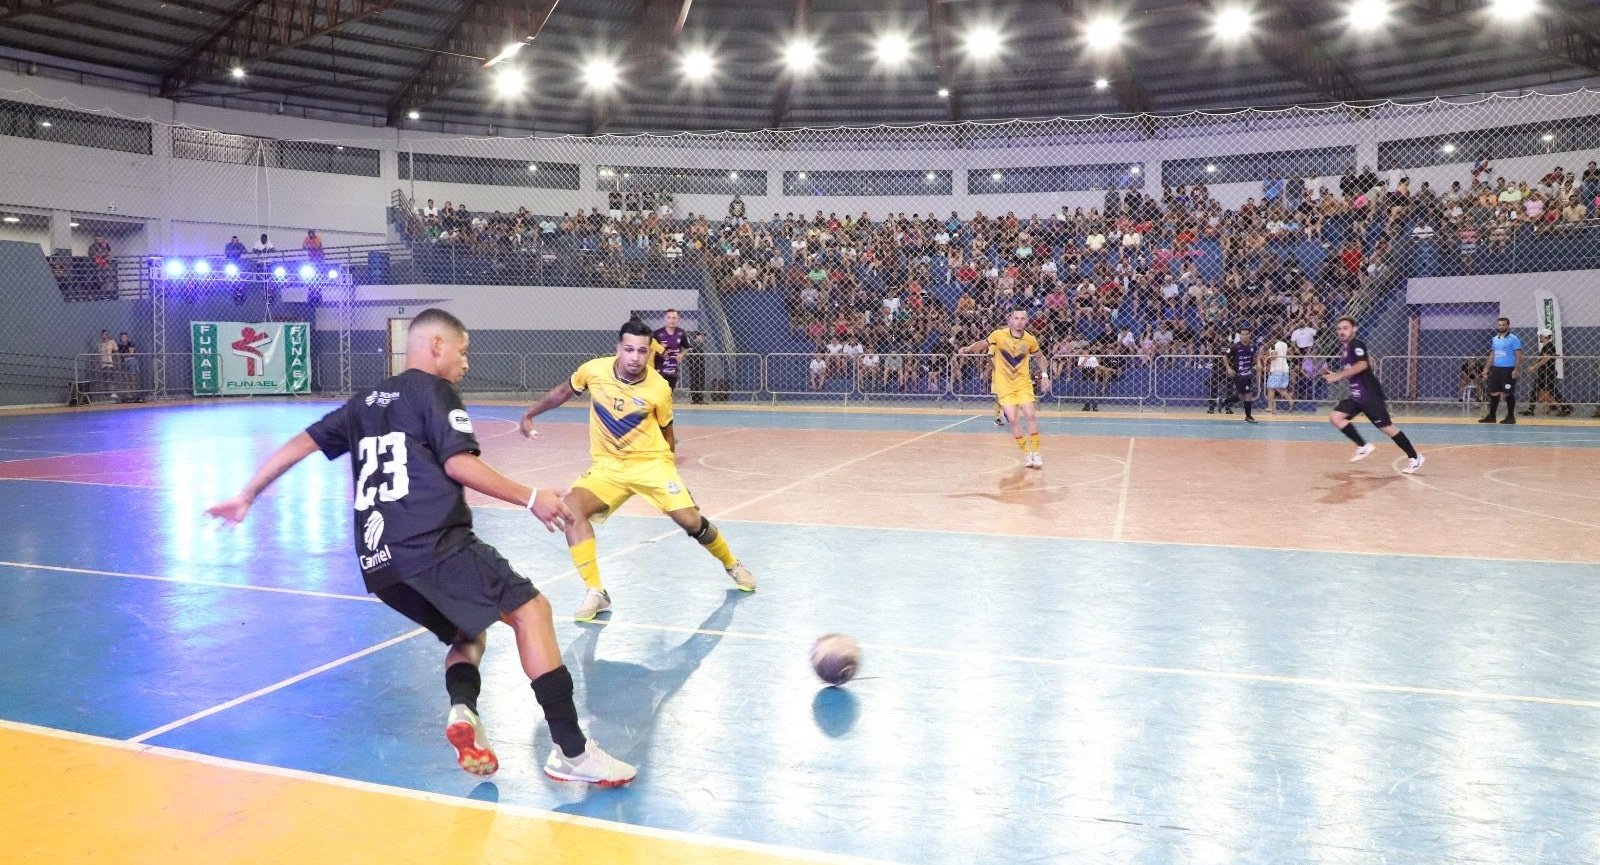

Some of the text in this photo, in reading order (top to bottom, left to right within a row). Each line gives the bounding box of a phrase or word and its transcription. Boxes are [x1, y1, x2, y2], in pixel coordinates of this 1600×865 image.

[200, 325, 211, 389] FUNAEL
[613, 397, 625, 412] 12
[354, 431, 410, 511] 23
